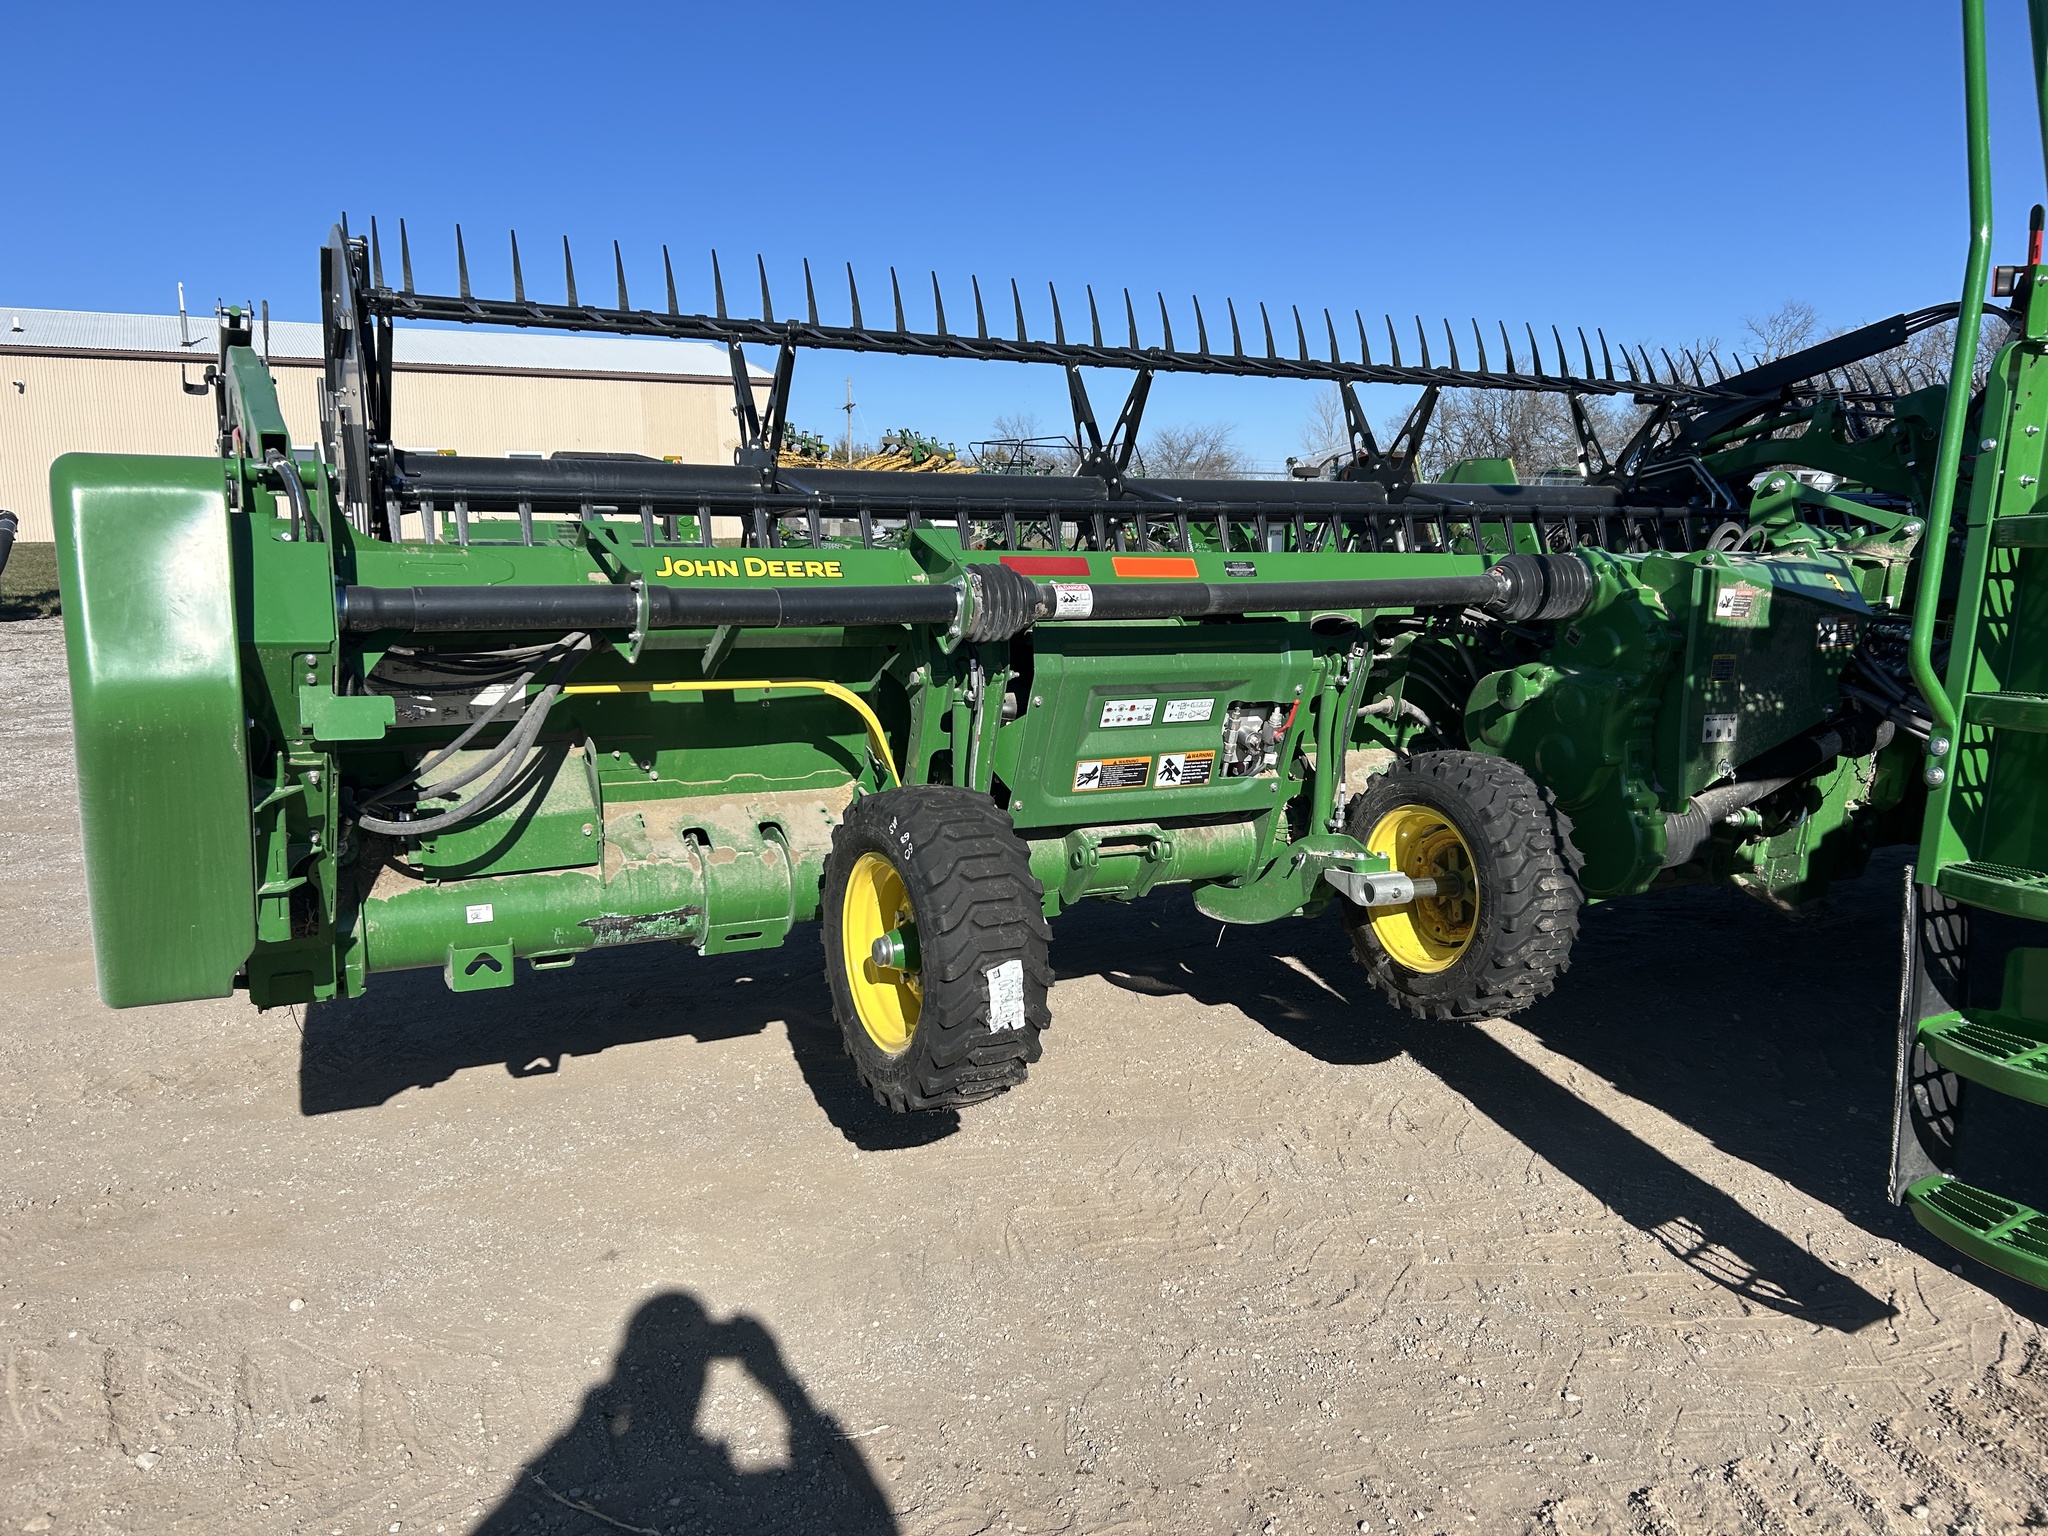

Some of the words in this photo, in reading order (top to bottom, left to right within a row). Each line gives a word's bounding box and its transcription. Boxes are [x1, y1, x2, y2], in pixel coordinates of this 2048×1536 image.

[656, 556, 740, 577] JOHN
[743, 556, 844, 578] DEERE
[1191, 752, 1214, 760] WARNING
